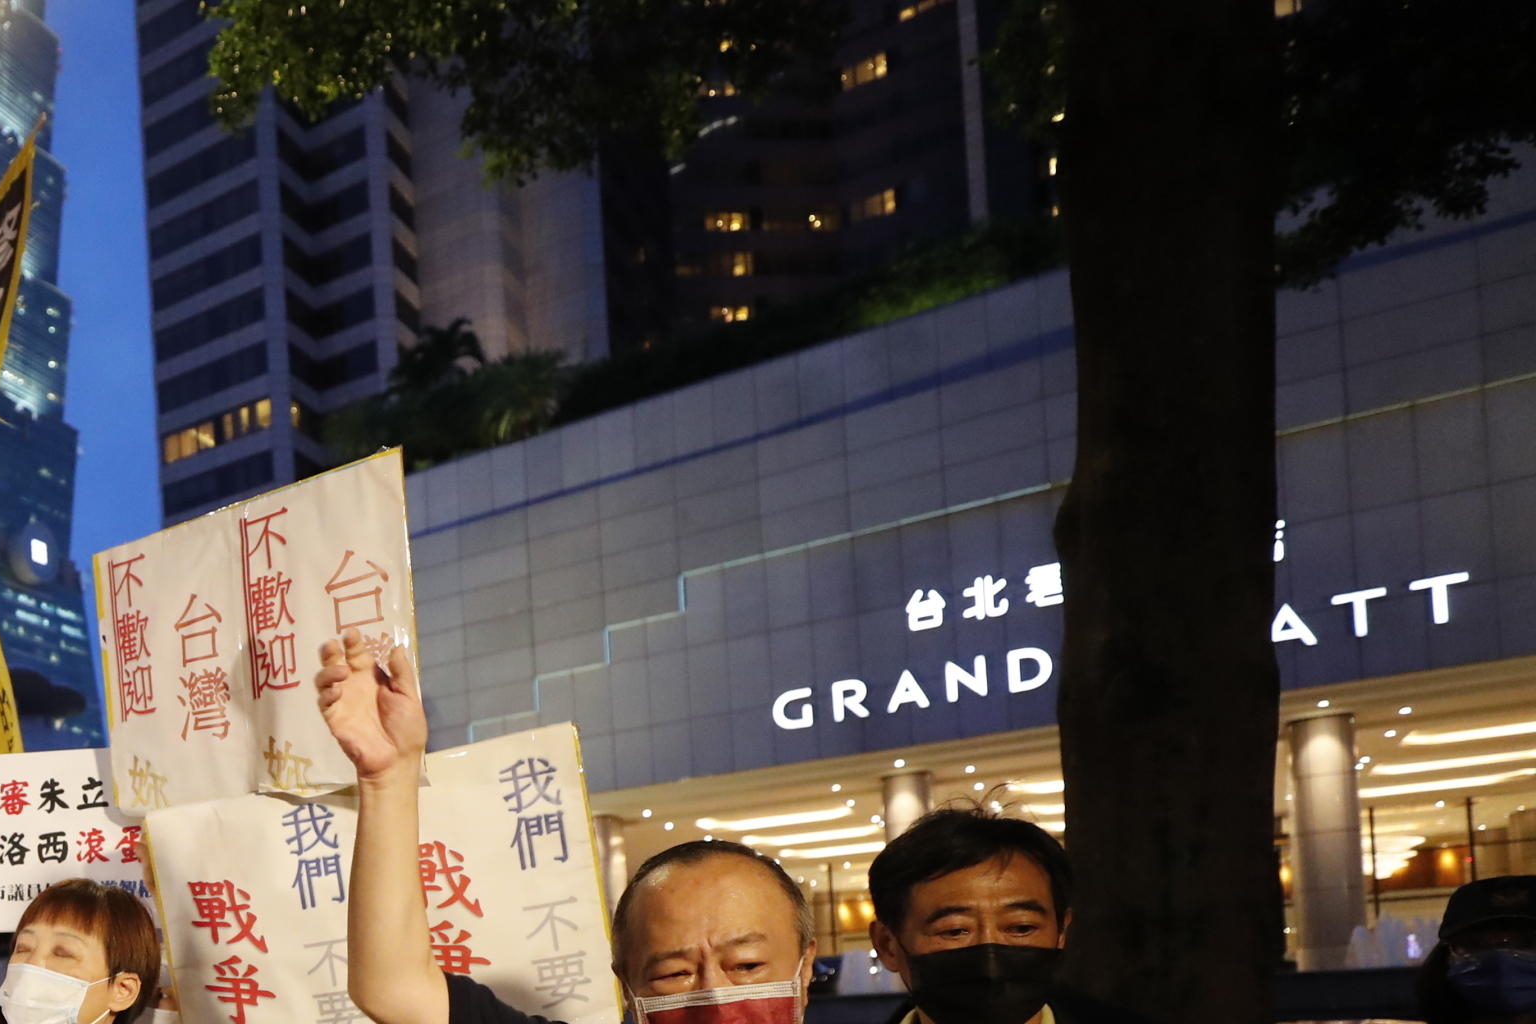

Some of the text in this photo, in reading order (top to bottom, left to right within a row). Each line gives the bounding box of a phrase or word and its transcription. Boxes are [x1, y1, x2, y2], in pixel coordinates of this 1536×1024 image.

[113, 553, 158, 717] 不歡迎
[173, 593, 232, 742] 台灣
[247, 506, 302, 693] 不歡迎
[772, 571, 1470, 730] GRAND ATT
[281, 803, 346, 911] 我們
[498, 757, 593, 1010] 我們 不要
